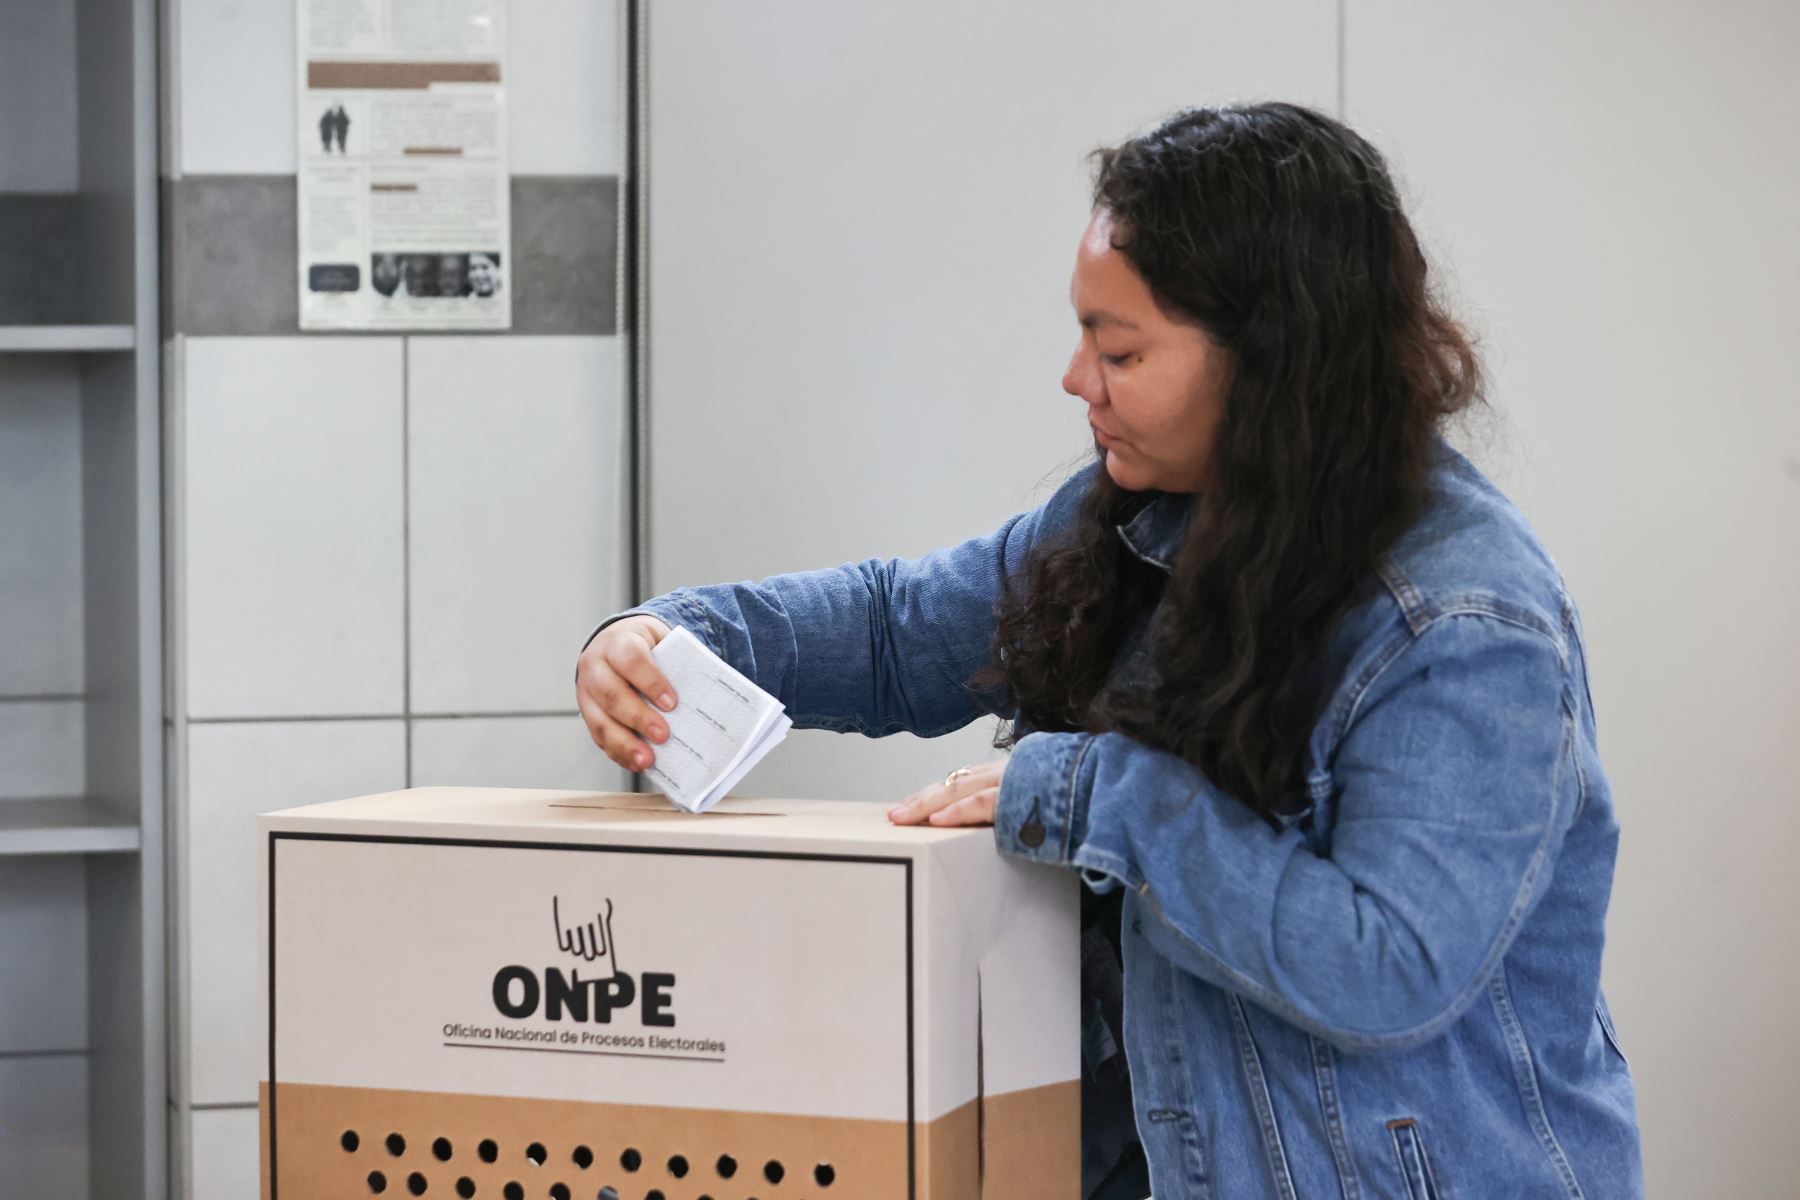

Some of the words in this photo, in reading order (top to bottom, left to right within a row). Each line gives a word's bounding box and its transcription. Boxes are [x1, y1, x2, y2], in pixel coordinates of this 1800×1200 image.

[493, 965, 676, 1028] ONPE
[443, 1024, 492, 1040] Oficina
[495, 1027, 556, 1043] Nacional
[560, 1029, 578, 1044] de
[581, 1031, 645, 1048] Procesos
[649, 1036, 726, 1052] Electorales
